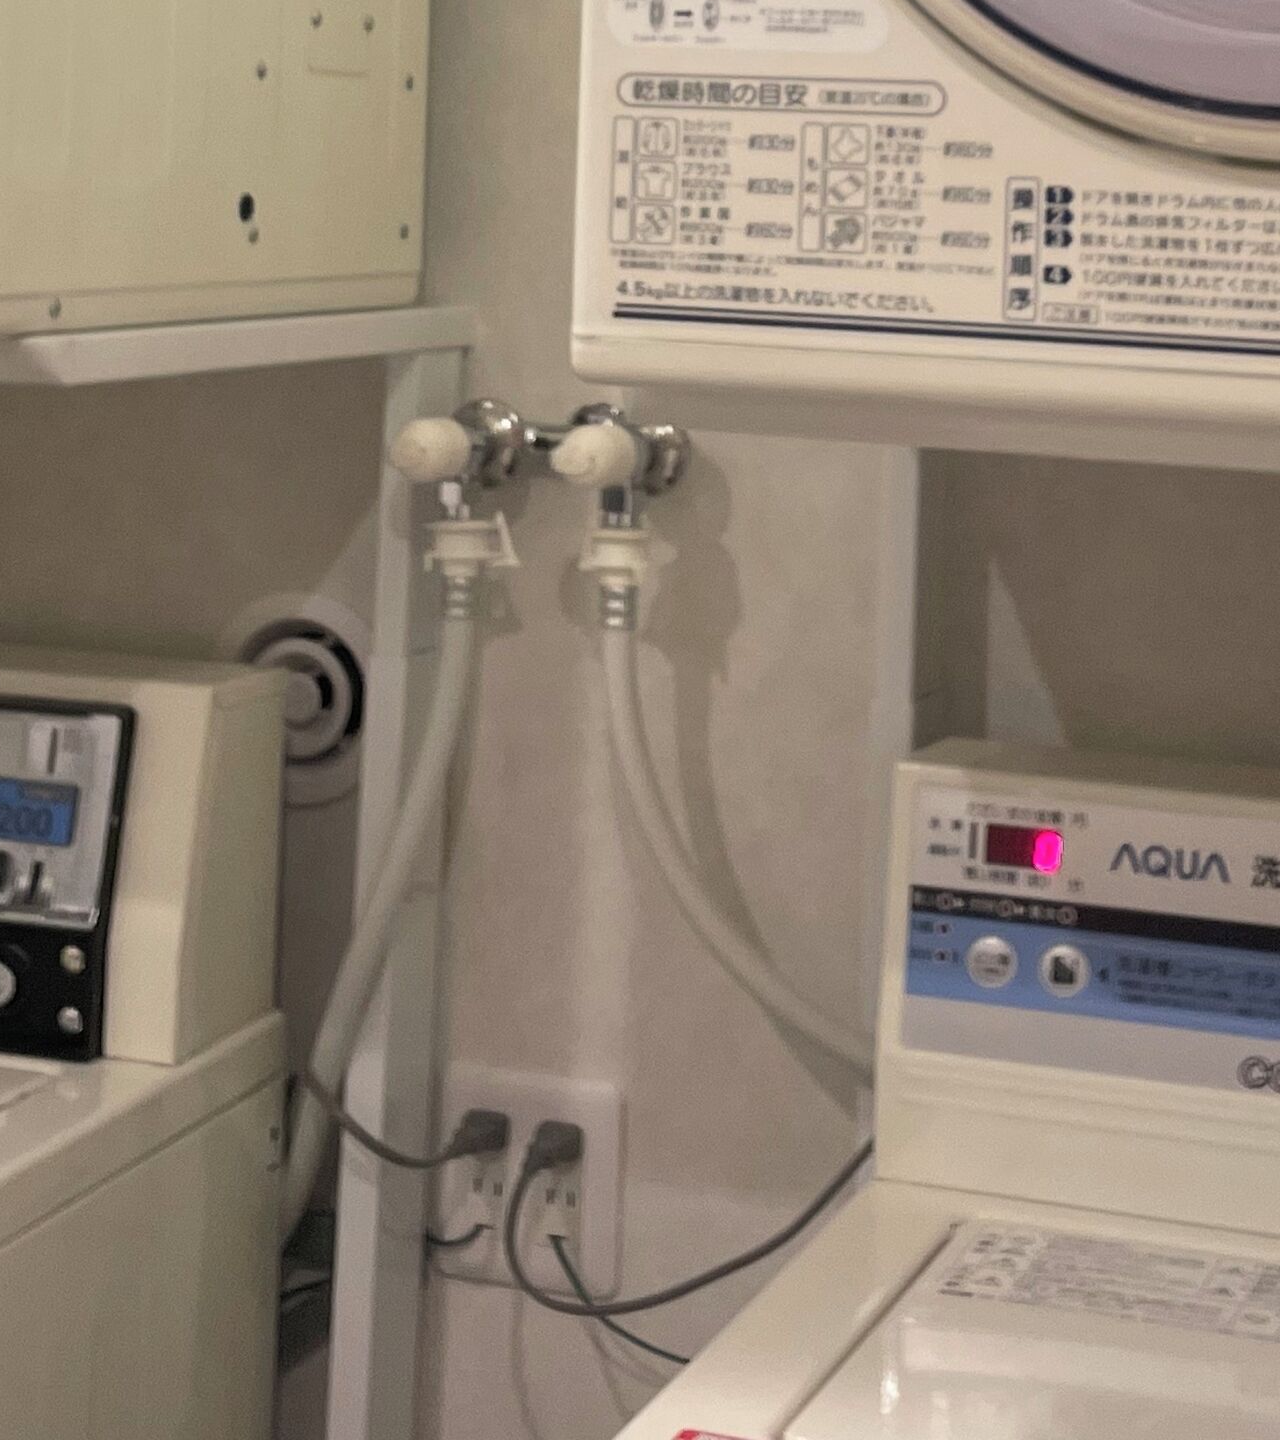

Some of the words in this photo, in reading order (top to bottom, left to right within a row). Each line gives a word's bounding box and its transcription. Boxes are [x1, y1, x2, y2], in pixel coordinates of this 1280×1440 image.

[632, 79, 810, 107] 乾燥時間の目安
[1109, 841, 1232, 885] AQUA
